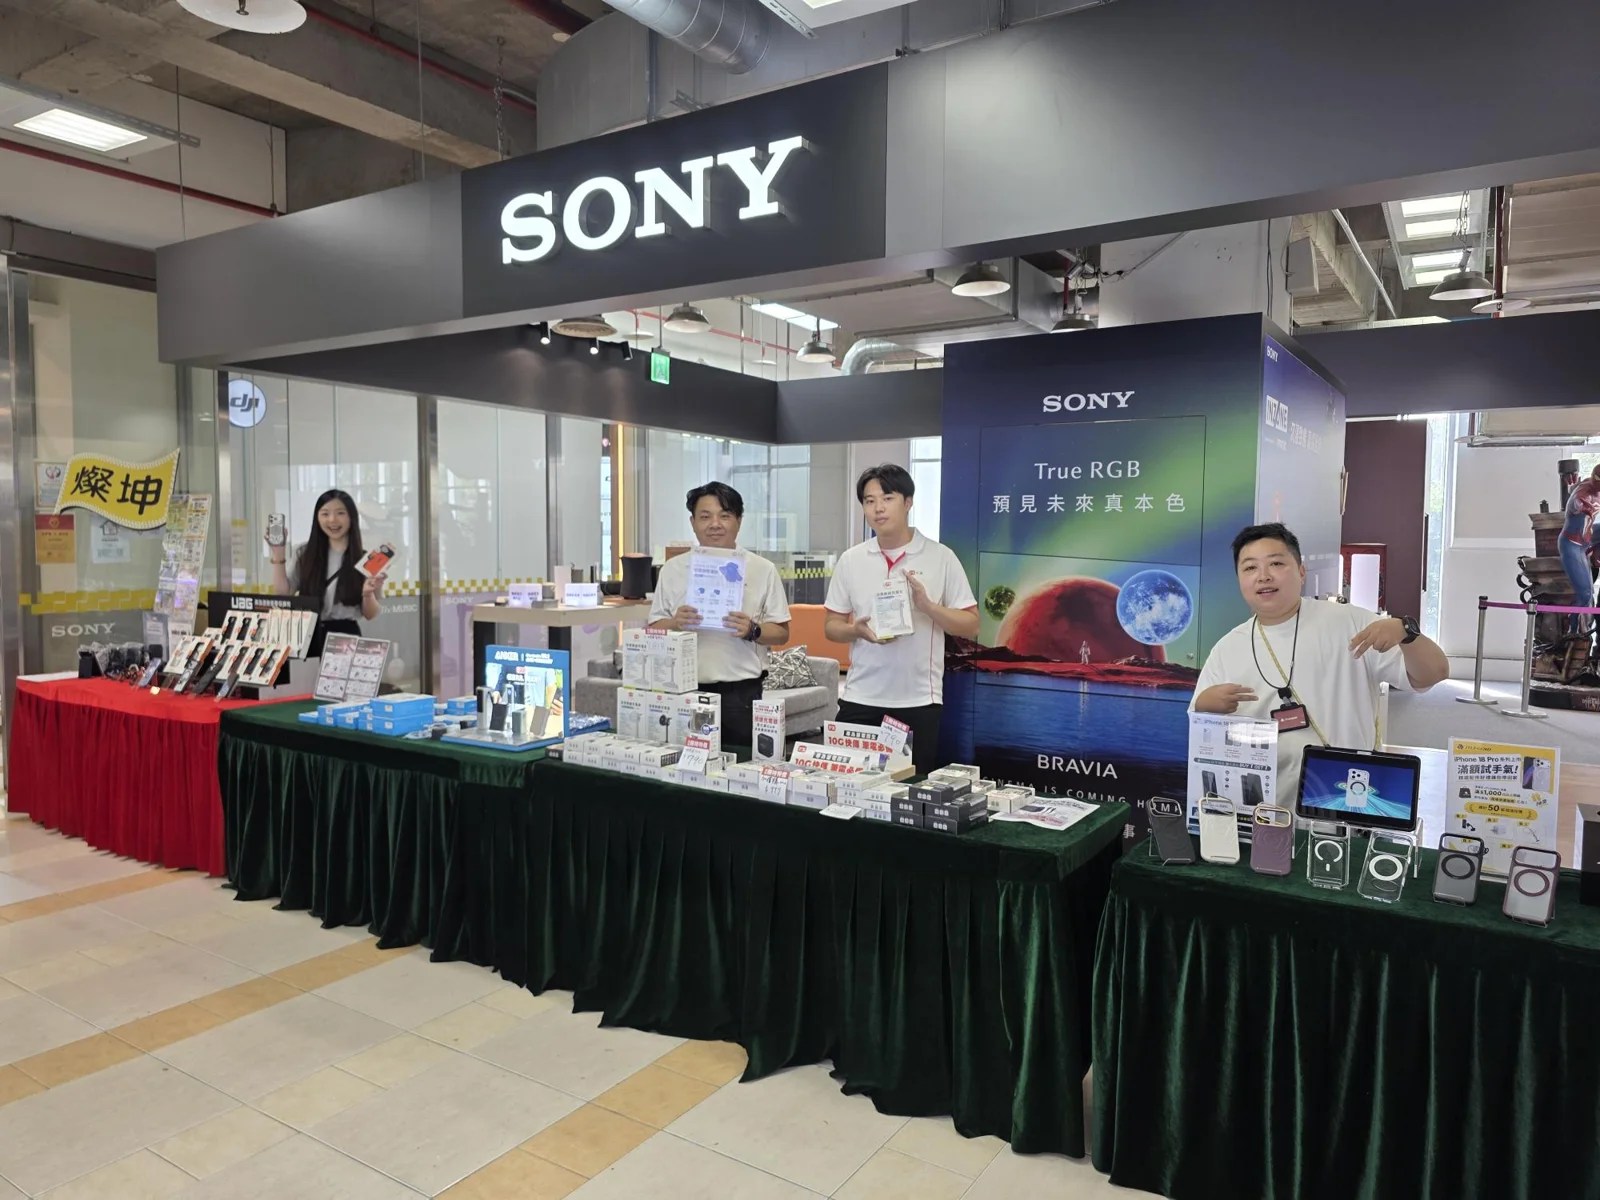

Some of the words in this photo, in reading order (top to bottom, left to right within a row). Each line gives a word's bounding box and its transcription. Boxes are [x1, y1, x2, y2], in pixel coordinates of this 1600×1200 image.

[500, 135, 805, 265] SONY
[1265, 345, 1279, 363] SONY
[1042, 390, 1135, 413] SONY
[1034, 462, 1083, 480] True
[1090, 460, 1140, 479] RGB
[70, 464, 163, 516] 燦坤
[992, 492, 1186, 514] 預見未來真本色
[51, 622, 117, 638] SONY
[1037, 753, 1118, 780] BRAVIA
[1457, 764, 1519, 774] 滿額試手氣!
[1044, 785, 1057, 796] IS
[1066, 788, 1127, 805] COMING
[1488, 804, 1500, 812] 50
